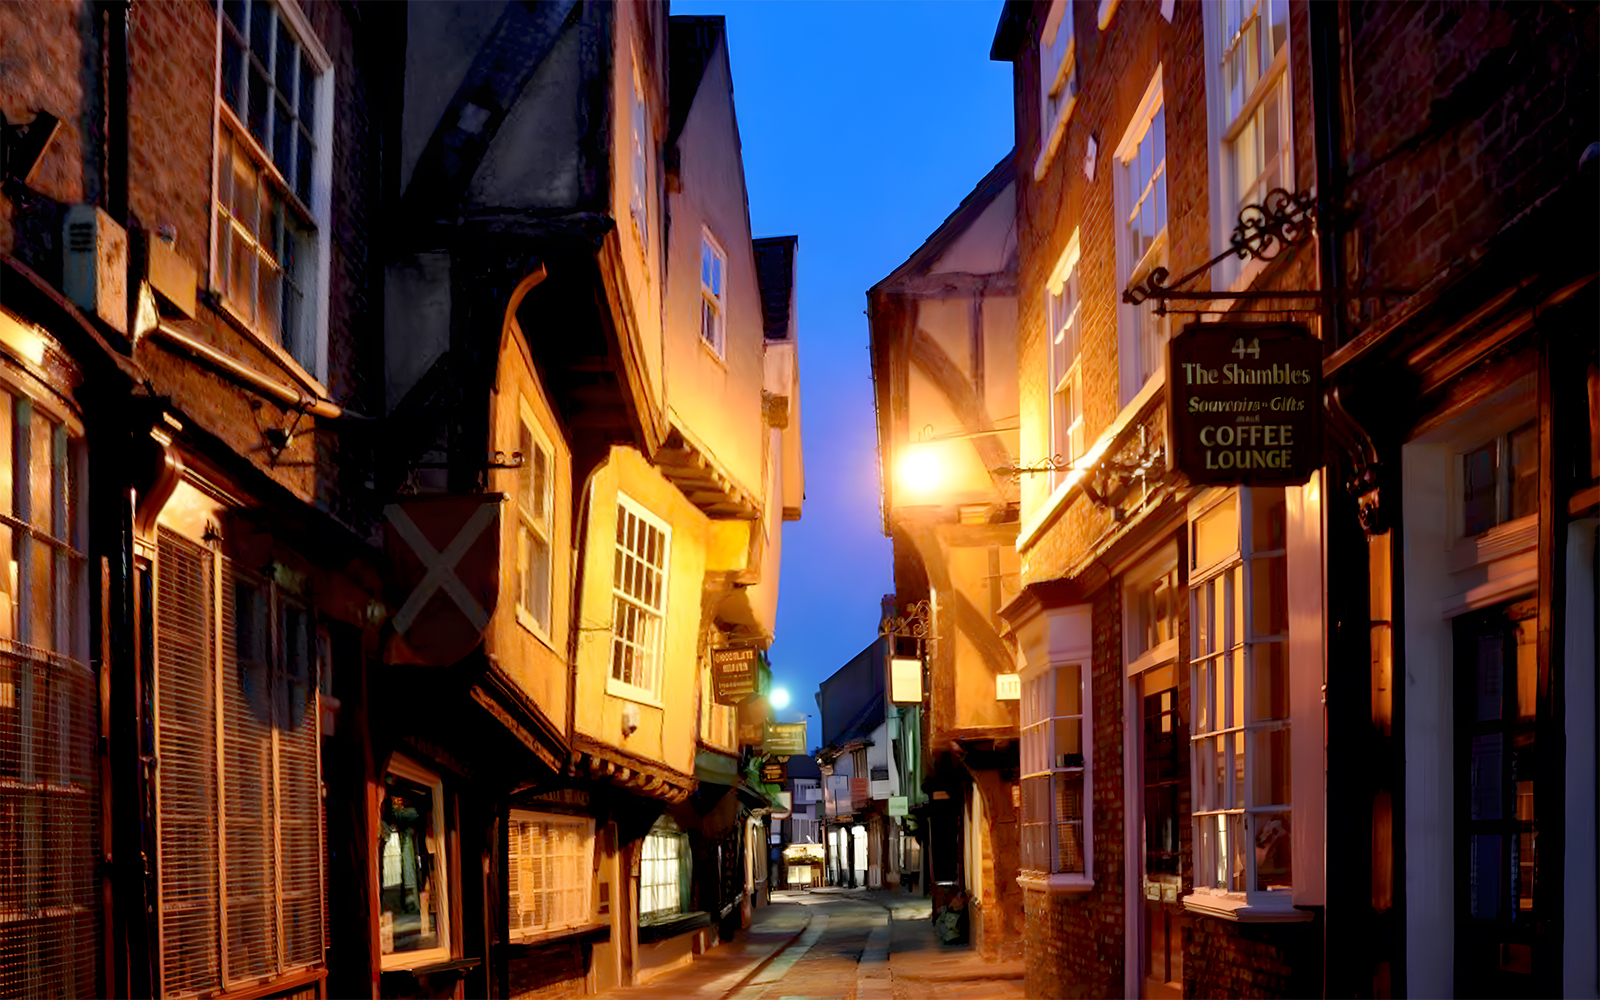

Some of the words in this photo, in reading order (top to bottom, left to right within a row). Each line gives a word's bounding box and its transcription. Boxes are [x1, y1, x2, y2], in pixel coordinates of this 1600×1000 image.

[1231, 337, 1261, 360] 44
[1182, 363, 1219, 386] The
[1222, 363, 1311, 385] Shambles
[1199, 425, 1294, 447] COFFEE
[1206, 450, 1292, 470] LOUNGE
